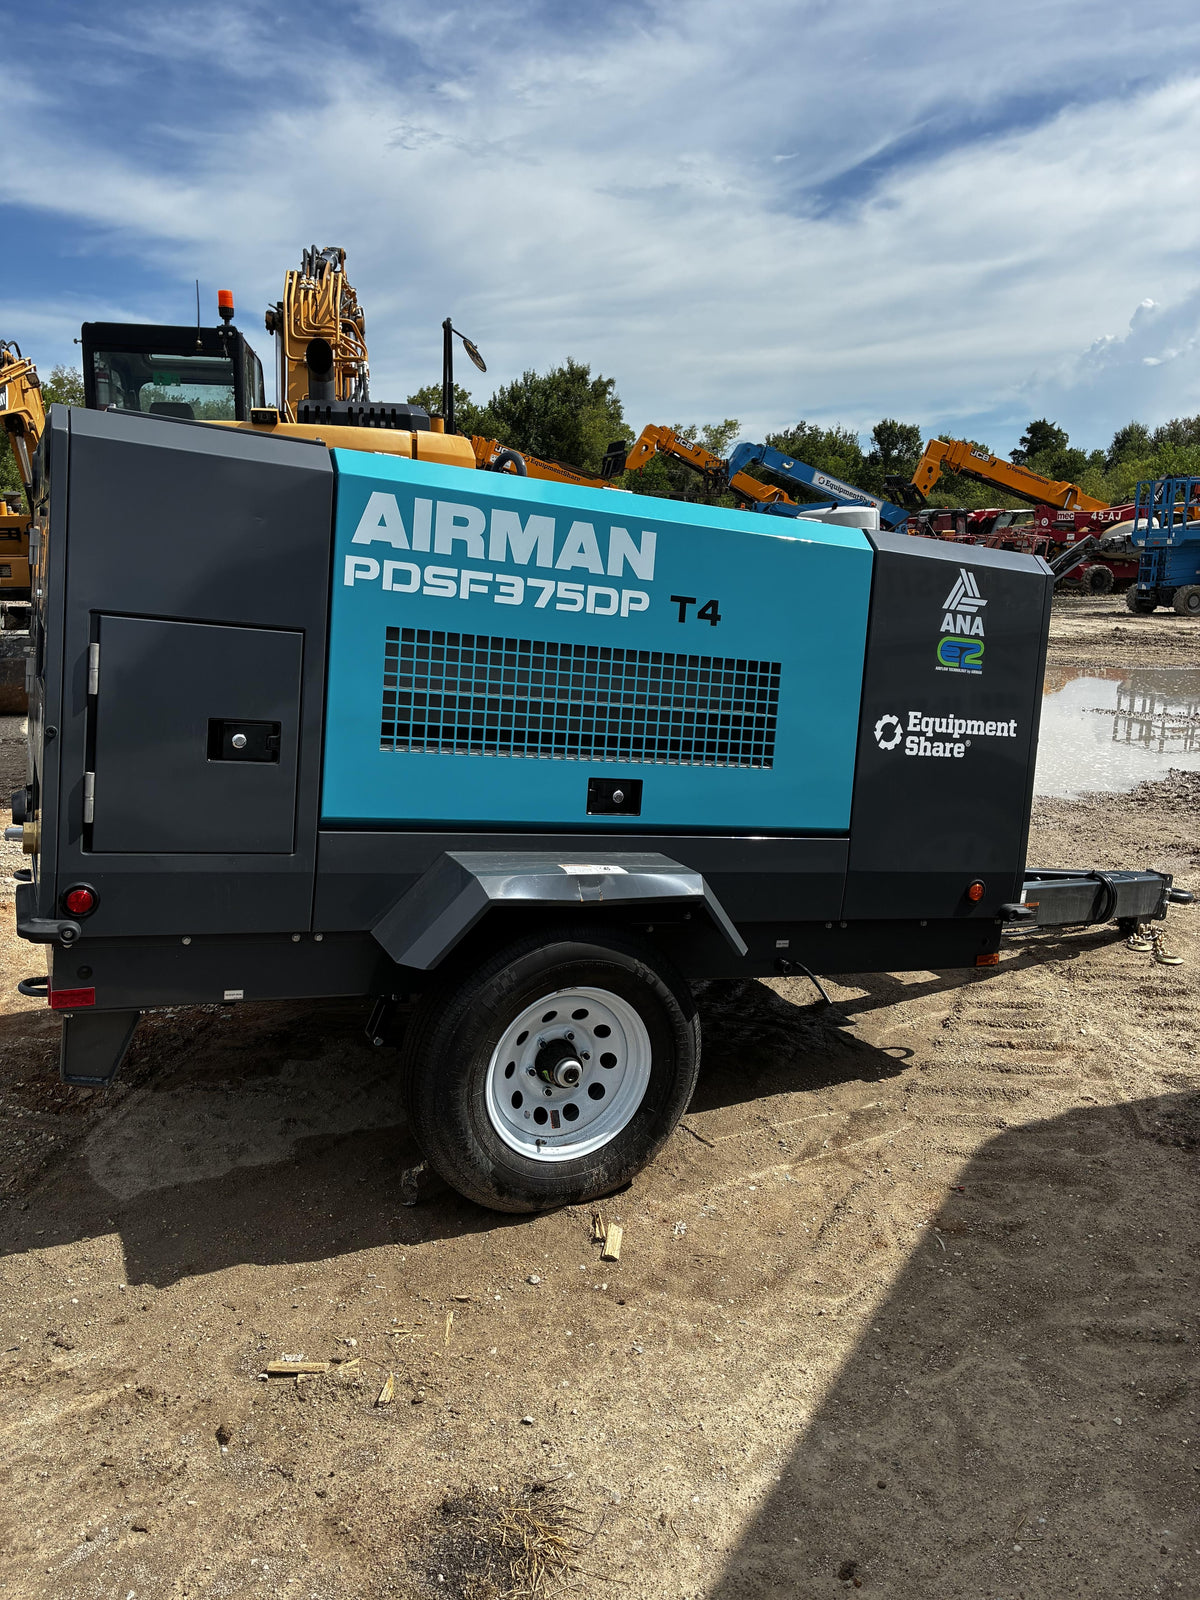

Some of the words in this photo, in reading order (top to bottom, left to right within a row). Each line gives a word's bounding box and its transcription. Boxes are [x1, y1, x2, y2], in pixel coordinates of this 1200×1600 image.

[674, 437, 694, 451] JCB
[970, 449, 991, 462] JCB
[1091, 511, 1122, 521] 45-AJ
[351, 491, 657, 581] AIRMAN
[343, 554, 650, 618] PDSF375DP
[669, 595, 722, 627] T4
[939, 612, 985, 637] ANA
[907, 711, 1017, 739] Equipment
